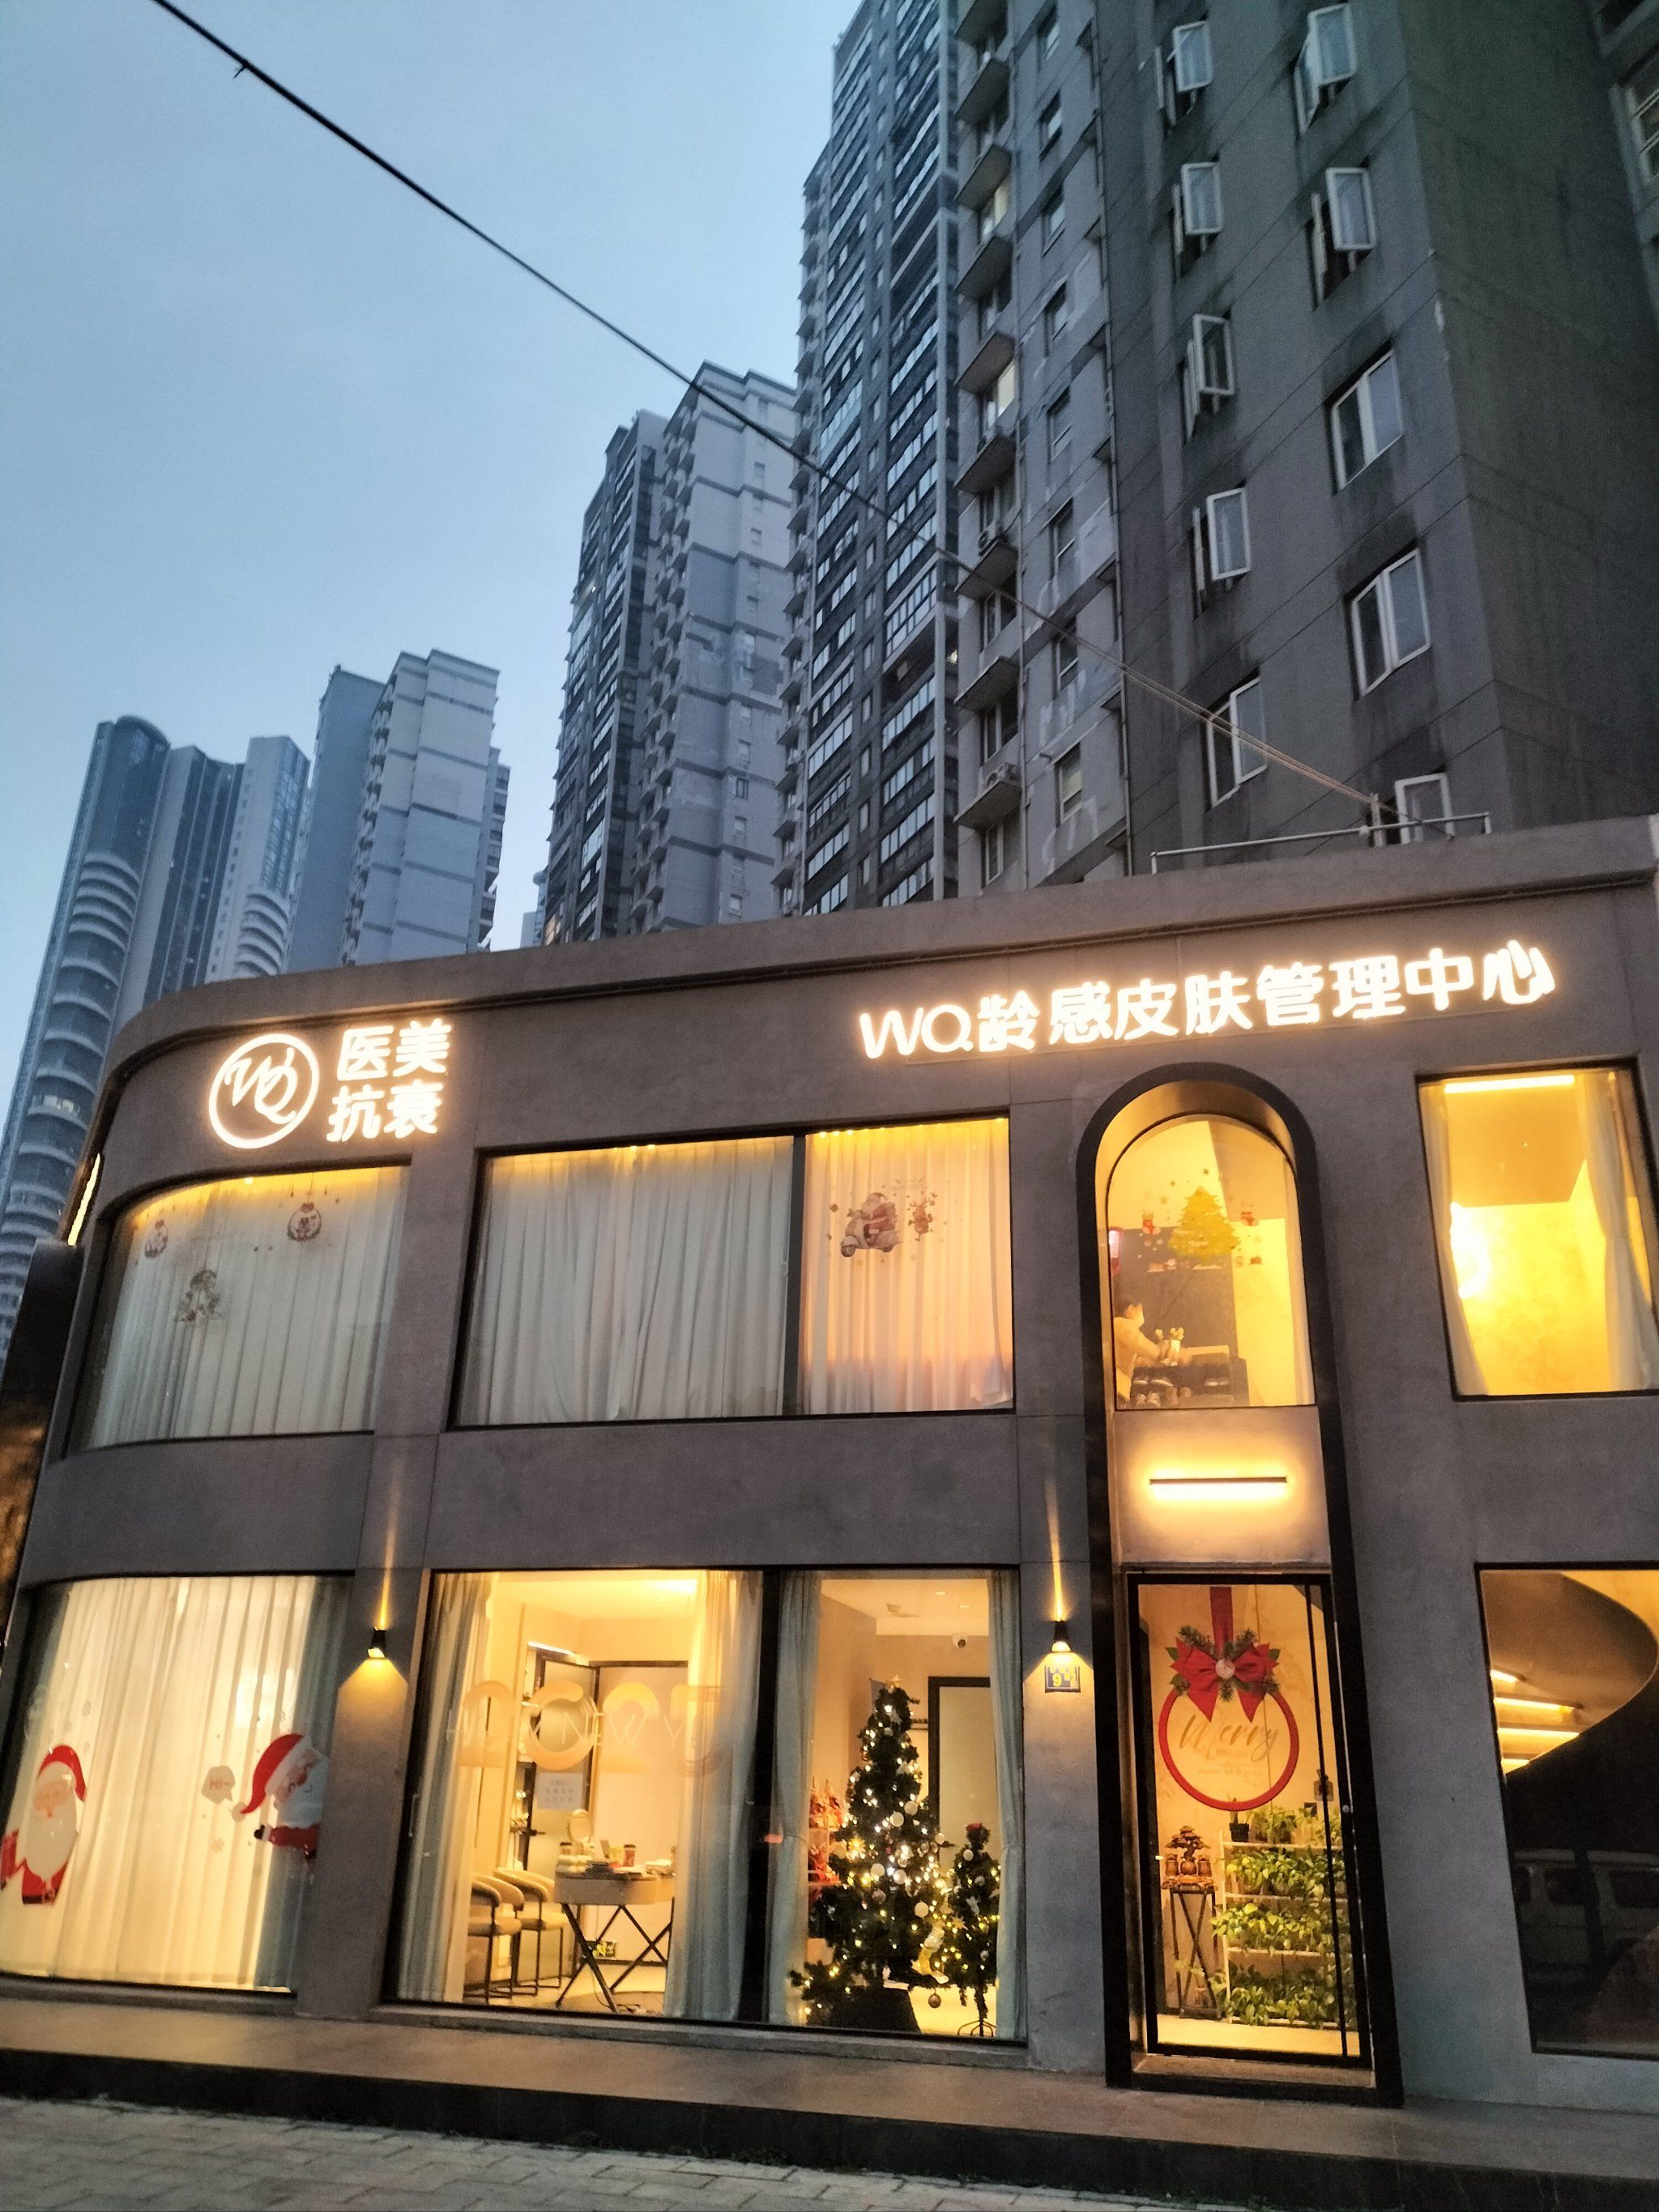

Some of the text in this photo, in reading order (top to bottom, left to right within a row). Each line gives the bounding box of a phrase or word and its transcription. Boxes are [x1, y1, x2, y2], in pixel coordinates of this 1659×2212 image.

[859, 939, 1556, 1060] WQ龄感皮肤管理中心
[336, 1017, 453, 1081] 医美
[326, 1079, 444, 1143] 抗衰
